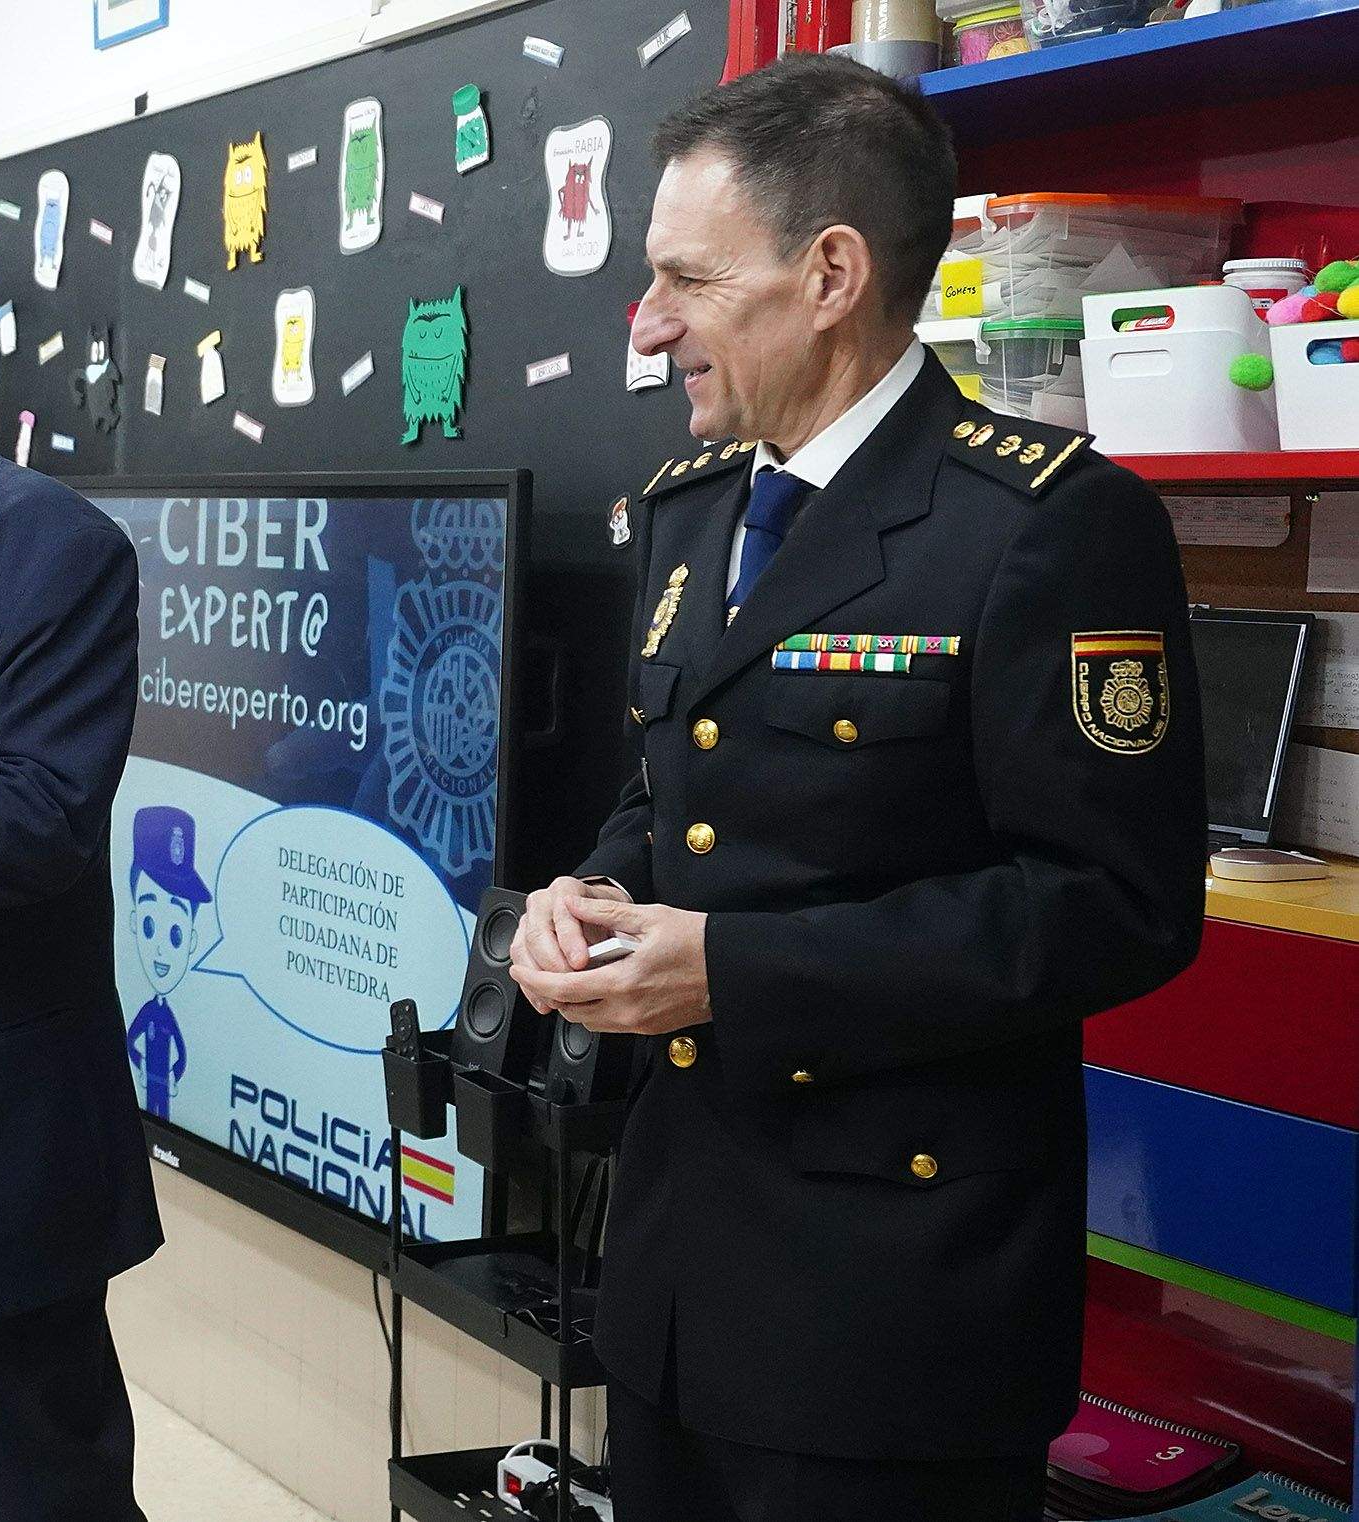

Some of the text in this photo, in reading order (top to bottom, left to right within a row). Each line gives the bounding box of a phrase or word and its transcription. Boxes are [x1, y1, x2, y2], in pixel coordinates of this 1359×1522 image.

[575, 136, 604, 154] RABIA
[159, 498, 330, 571] CIBER
[160, 583, 329, 657] EXPERT@
[141, 657, 368, 751] ciberexperto.org
[1087, 723, 1154, 748] NACIONAL
[278, 846, 405, 898] DELEGACIÓN DE
[282, 881, 398, 932] PARTICIPACIÓN
[279, 914, 399, 969] CIUDADANA DE
[286, 950, 391, 1003] PONTEVEDRA
[1155, 1446, 1185, 1460] 3
